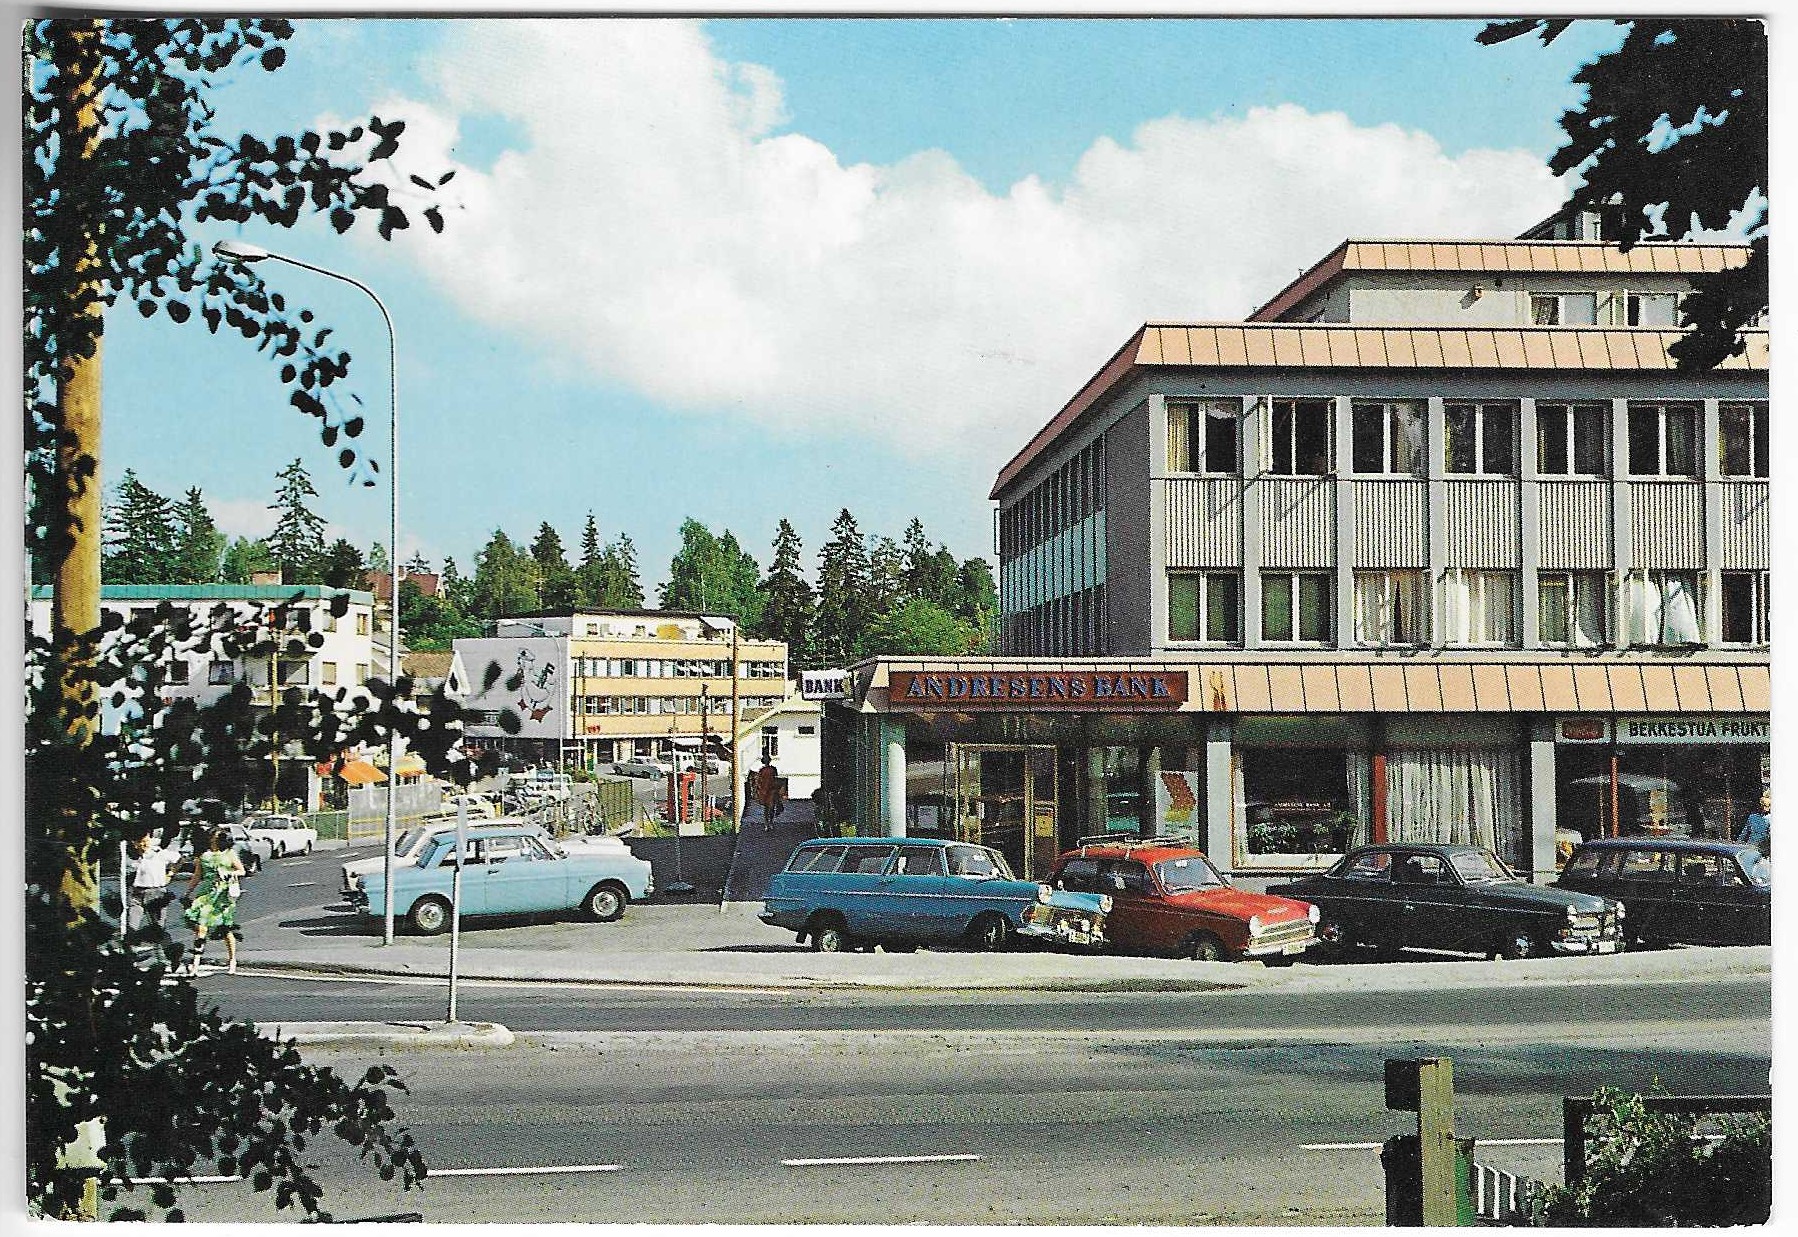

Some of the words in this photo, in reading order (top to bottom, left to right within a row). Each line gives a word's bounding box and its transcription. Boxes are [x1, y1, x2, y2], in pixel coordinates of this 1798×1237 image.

[804, 678, 844, 694] BANK
[906, 676, 1089, 698] ANDRESENS
[1094, 676, 1171, 698] BANK
[1628, 721, 1717, 738] BEKKESTUA
